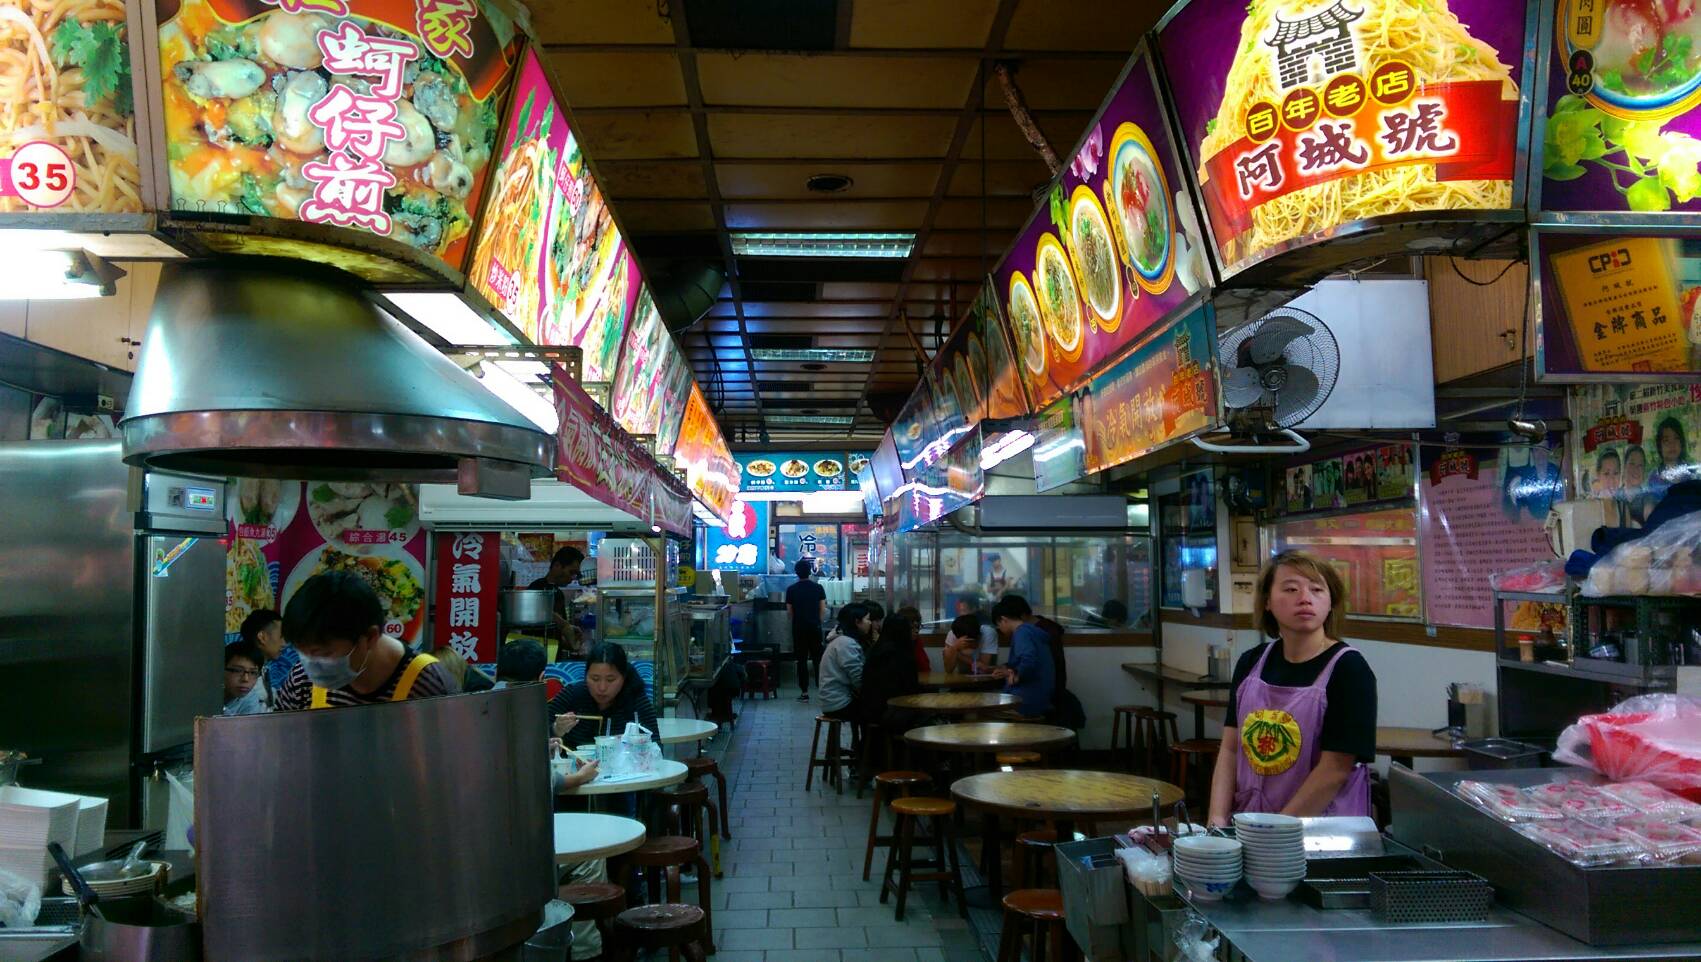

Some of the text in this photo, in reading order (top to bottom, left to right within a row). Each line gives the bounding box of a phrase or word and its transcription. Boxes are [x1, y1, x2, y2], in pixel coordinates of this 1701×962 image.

[1576, 56, 1588, 69] A
[1572, 74, 1590, 87] 40
[1247, 69, 1410, 135] 百年老店
[305, 26, 416, 233] 蚵仔煎
[1238, 103, 1456, 197] 阿城號
[18, 162, 68, 191] 35
[1593, 306, 1667, 341] 金牌商品
[349, 531, 407, 543] 綜合湯 45
[450, 532, 483, 662] 冷氣開放
[386, 624, 401, 633] 60
